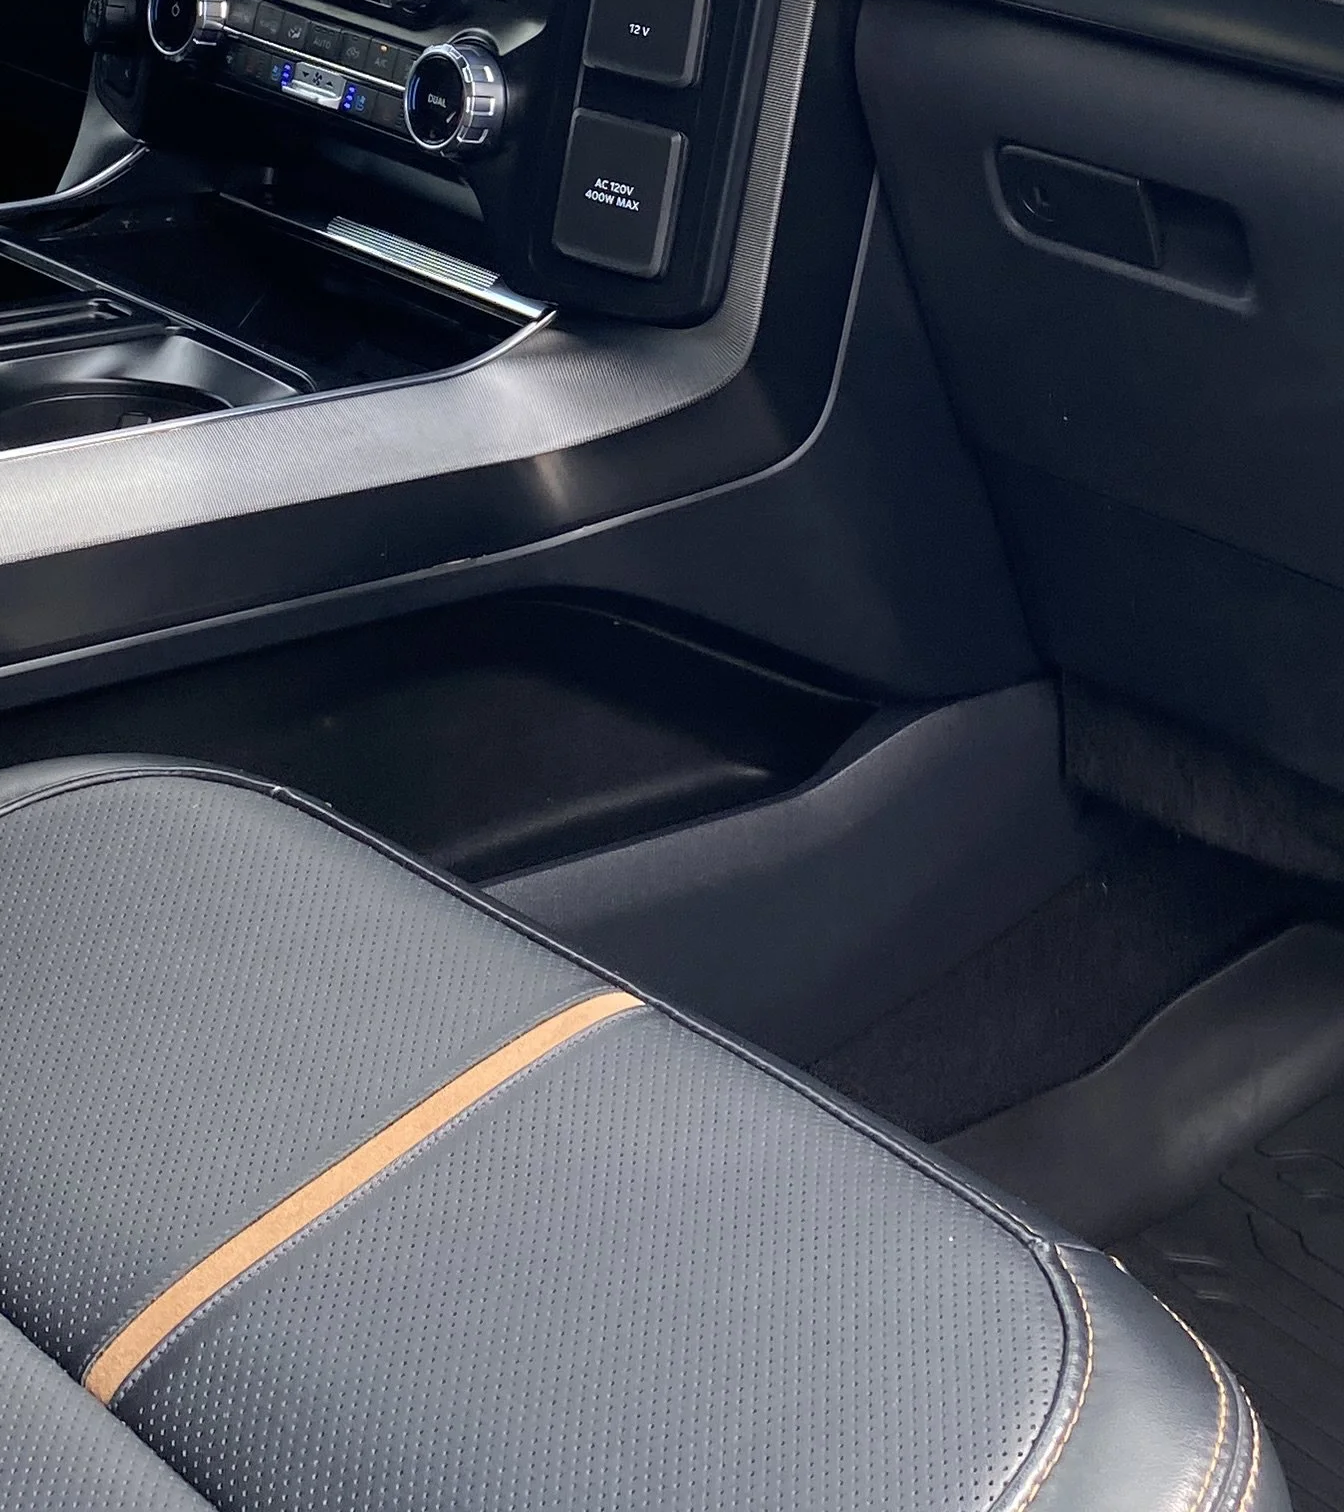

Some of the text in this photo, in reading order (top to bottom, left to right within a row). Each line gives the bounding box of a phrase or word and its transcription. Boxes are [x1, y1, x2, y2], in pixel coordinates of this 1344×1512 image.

[629, 23, 650, 37] 12 V
[313, 39, 332, 50] AUTO
[427, 93, 447, 108] DUAL
[594, 178, 635, 196] AC 120V
[584, 189, 640, 211] 400W MAX
